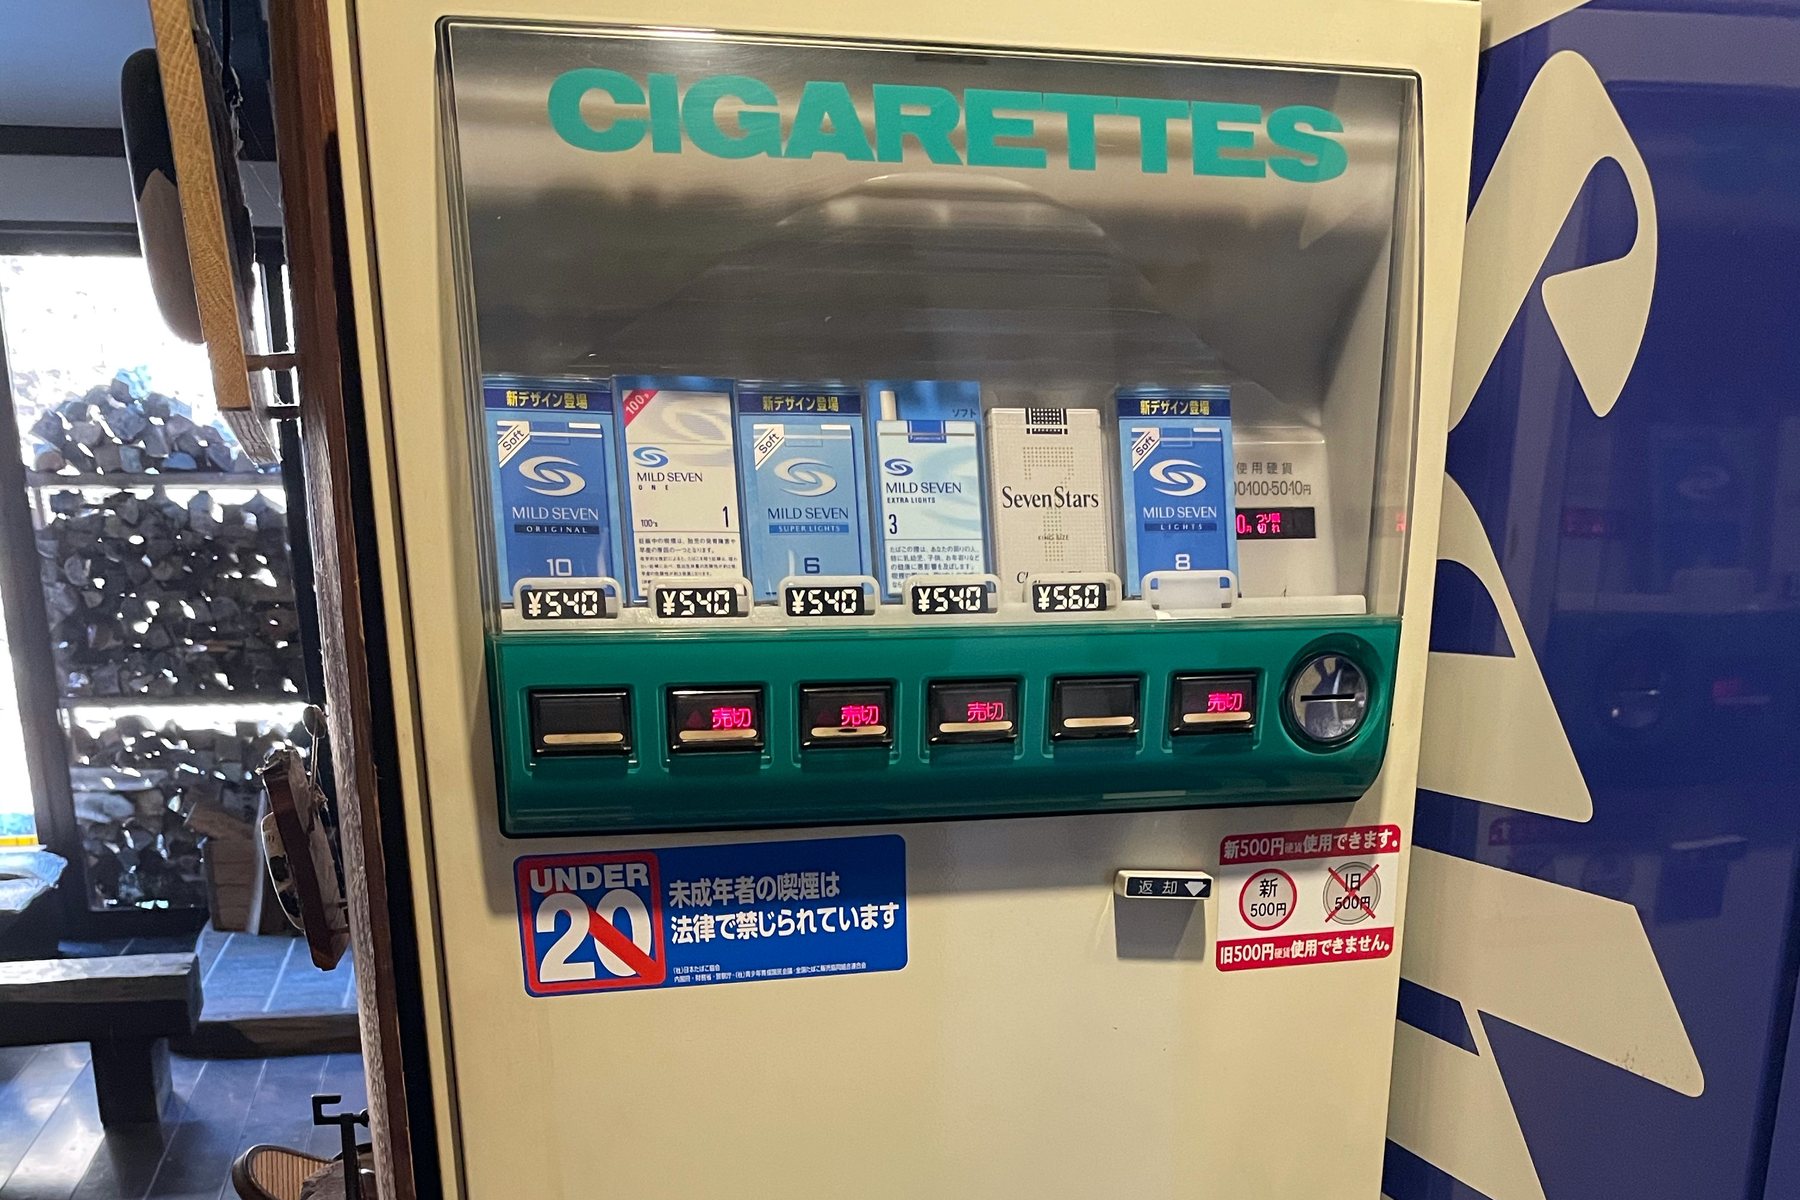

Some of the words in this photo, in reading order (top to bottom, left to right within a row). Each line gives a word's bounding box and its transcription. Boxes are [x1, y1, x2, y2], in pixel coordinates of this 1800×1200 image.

[546, 67, 1349, 184] CIGARETTES
[506, 390, 588, 409] 新デザイン登場
[762, 396, 839, 412] 新デザイン登場
[1139, 400, 1210, 416] 新デザイン登場
[952, 408, 977, 418] ソフト
[502, 430, 525, 451] Soft
[758, 433, 780, 454] Soft
[1135, 436, 1156, 456] Soft
[637, 472, 665, 482] MILD
[667, 472, 703, 482] SEVEN
[1236, 462, 1293, 475] 使用硬貨
[885, 482, 918, 493] MILD
[921, 482, 961, 494] SEVEN
[512, 506, 549, 520] MILD
[552, 507, 599, 521] SEVEN
[722, 505, 729, 528] 1
[767, 507, 802, 519] MILD
[805, 507, 849, 520] SEVEN
[1143, 506, 1175, 518] MILD
[1177, 506, 1217, 519] SEVEN
[526, 525, 587, 533] ORIGINAL
[888, 513, 898, 534] 3
[546, 558, 573, 577] 10
[803, 557, 821, 574] 6
[1175, 553, 1191, 571] 8
[527, 590, 598, 617] ¥540
[662, 589, 730, 616] ¥540
[791, 589, 857, 615] ¥540
[917, 586, 981, 612] ¥540
[1038, 584, 1100, 610] ¥560
[967, 701, 1005, 722] 売切
[1207, 693, 1243, 712] 売切
[711, 707, 752, 728] 売切
[841, 705, 879, 726] 売切
[529, 863, 649, 893] UNDER
[1259, 877, 1278, 898] 新
[1345, 873, 1361, 892] 旧
[668, 871, 840, 909] 未成年者の喫煙は
[1138, 880, 1178, 896] 返却
[1250, 902, 1287, 918] 500円
[1334, 896, 1371, 910] 500円
[670, 902, 900, 945] 法律で禁じられています
[535, 887, 652, 984] 20
